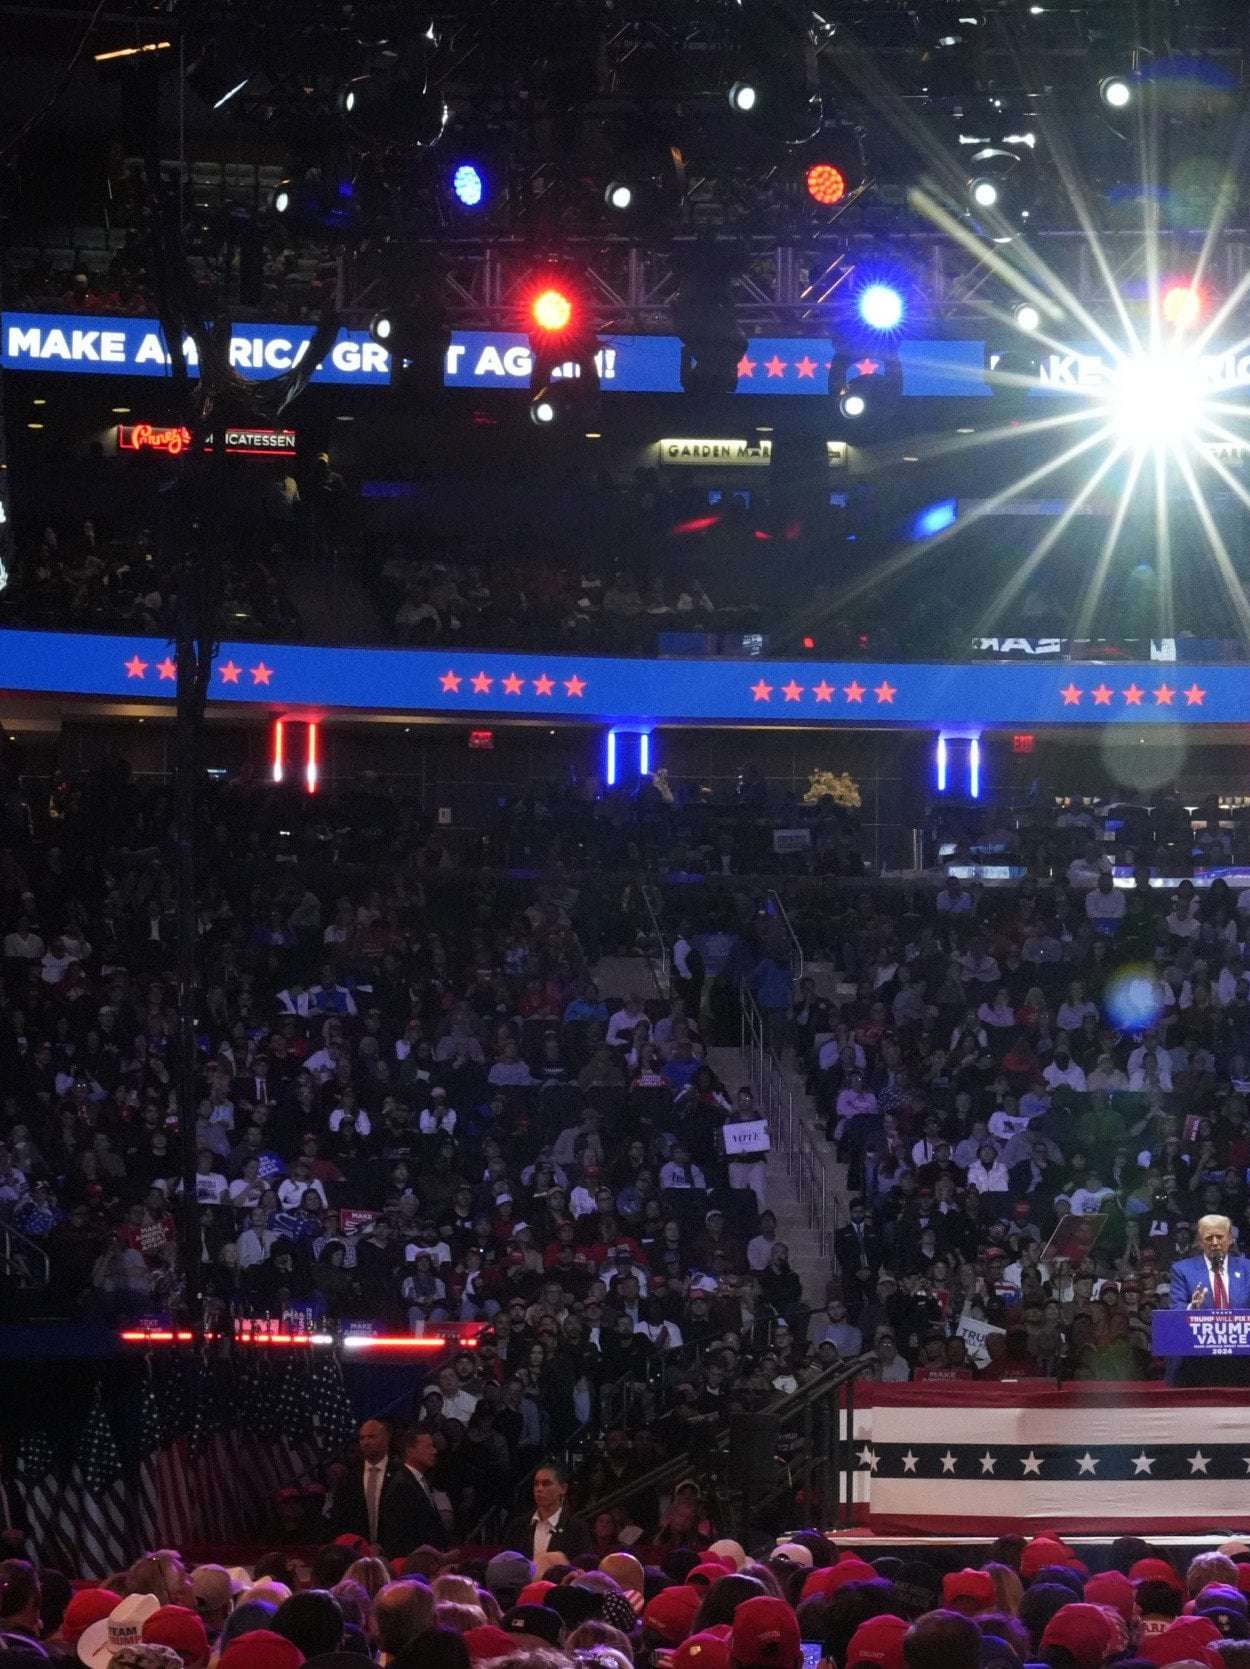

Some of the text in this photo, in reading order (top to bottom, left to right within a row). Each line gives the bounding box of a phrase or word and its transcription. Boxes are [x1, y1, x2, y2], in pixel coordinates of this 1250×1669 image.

[8, 327, 126, 362] MAKE
[332, 341, 465, 374] GRT
[668, 445, 731, 458] GARDEN
[1197, 1335, 1247, 1344] VANCE
